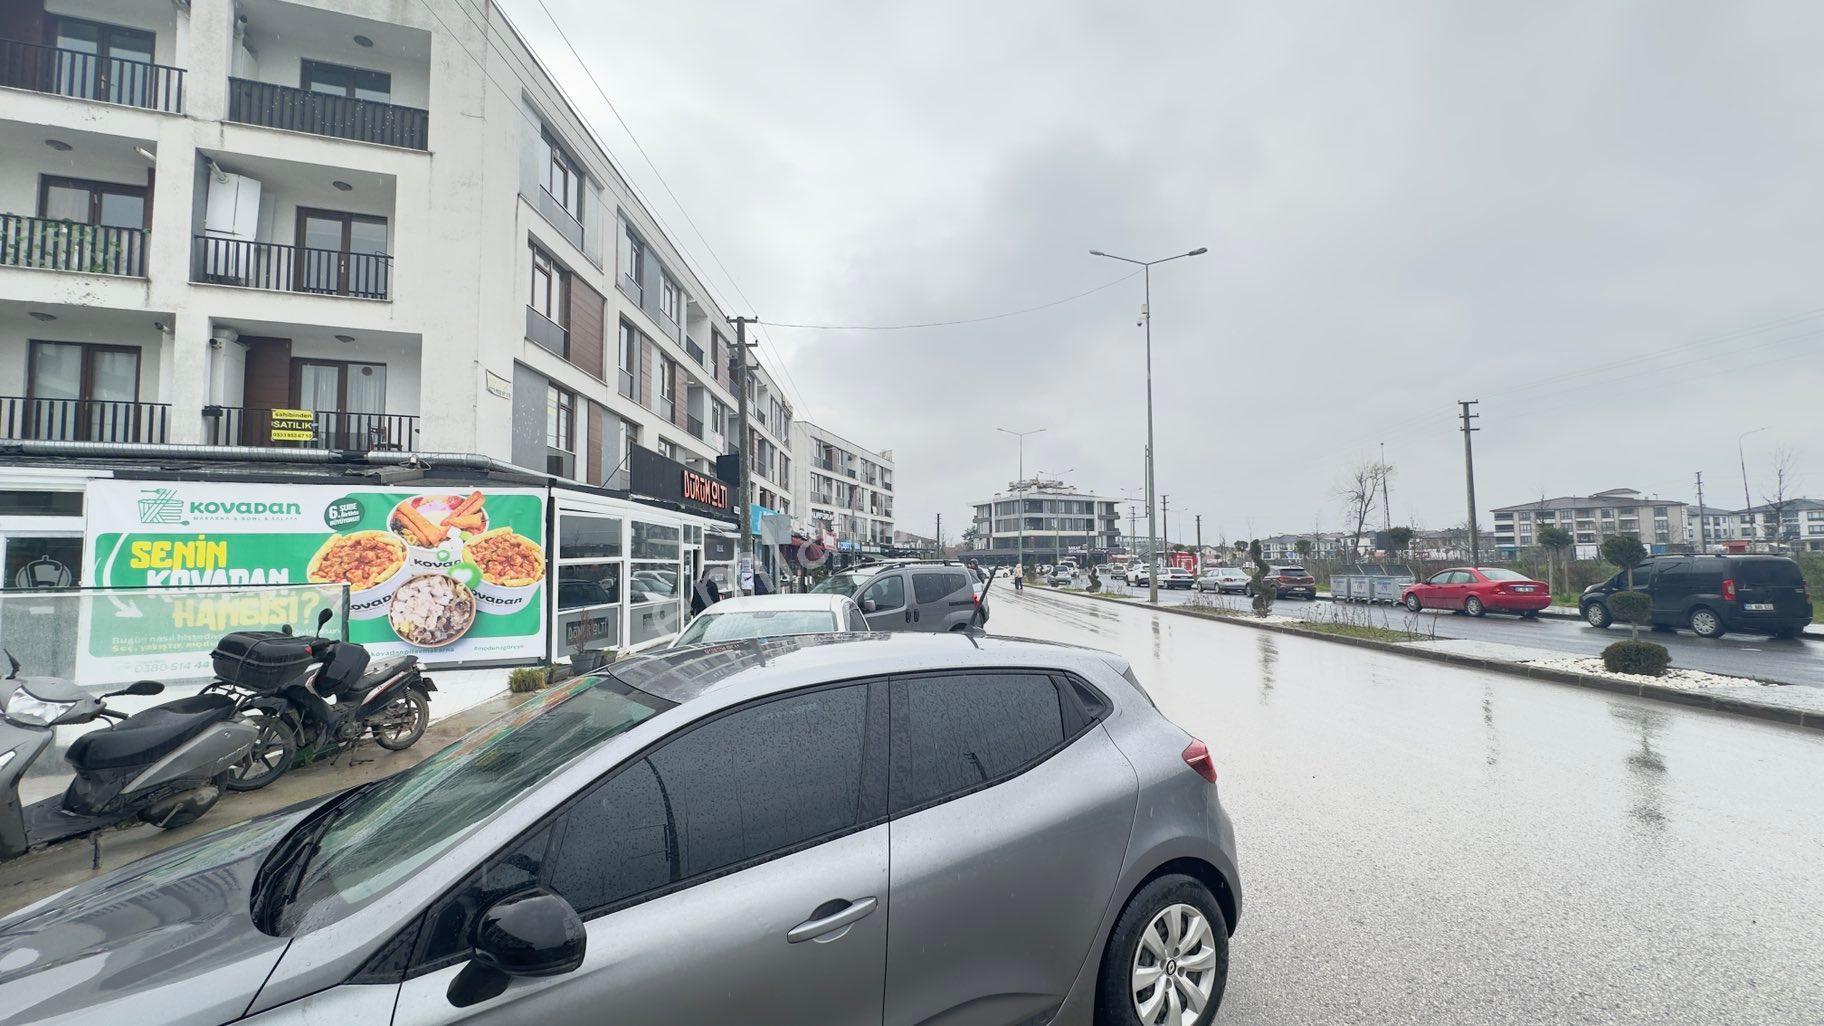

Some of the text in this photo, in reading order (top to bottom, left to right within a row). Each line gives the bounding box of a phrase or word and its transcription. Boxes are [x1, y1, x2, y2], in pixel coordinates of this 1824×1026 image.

[273, 420, 312, 430] SATILIK
[130, 534, 228, 571] SENİN
[147, 567, 290, 601] KOVADAN
